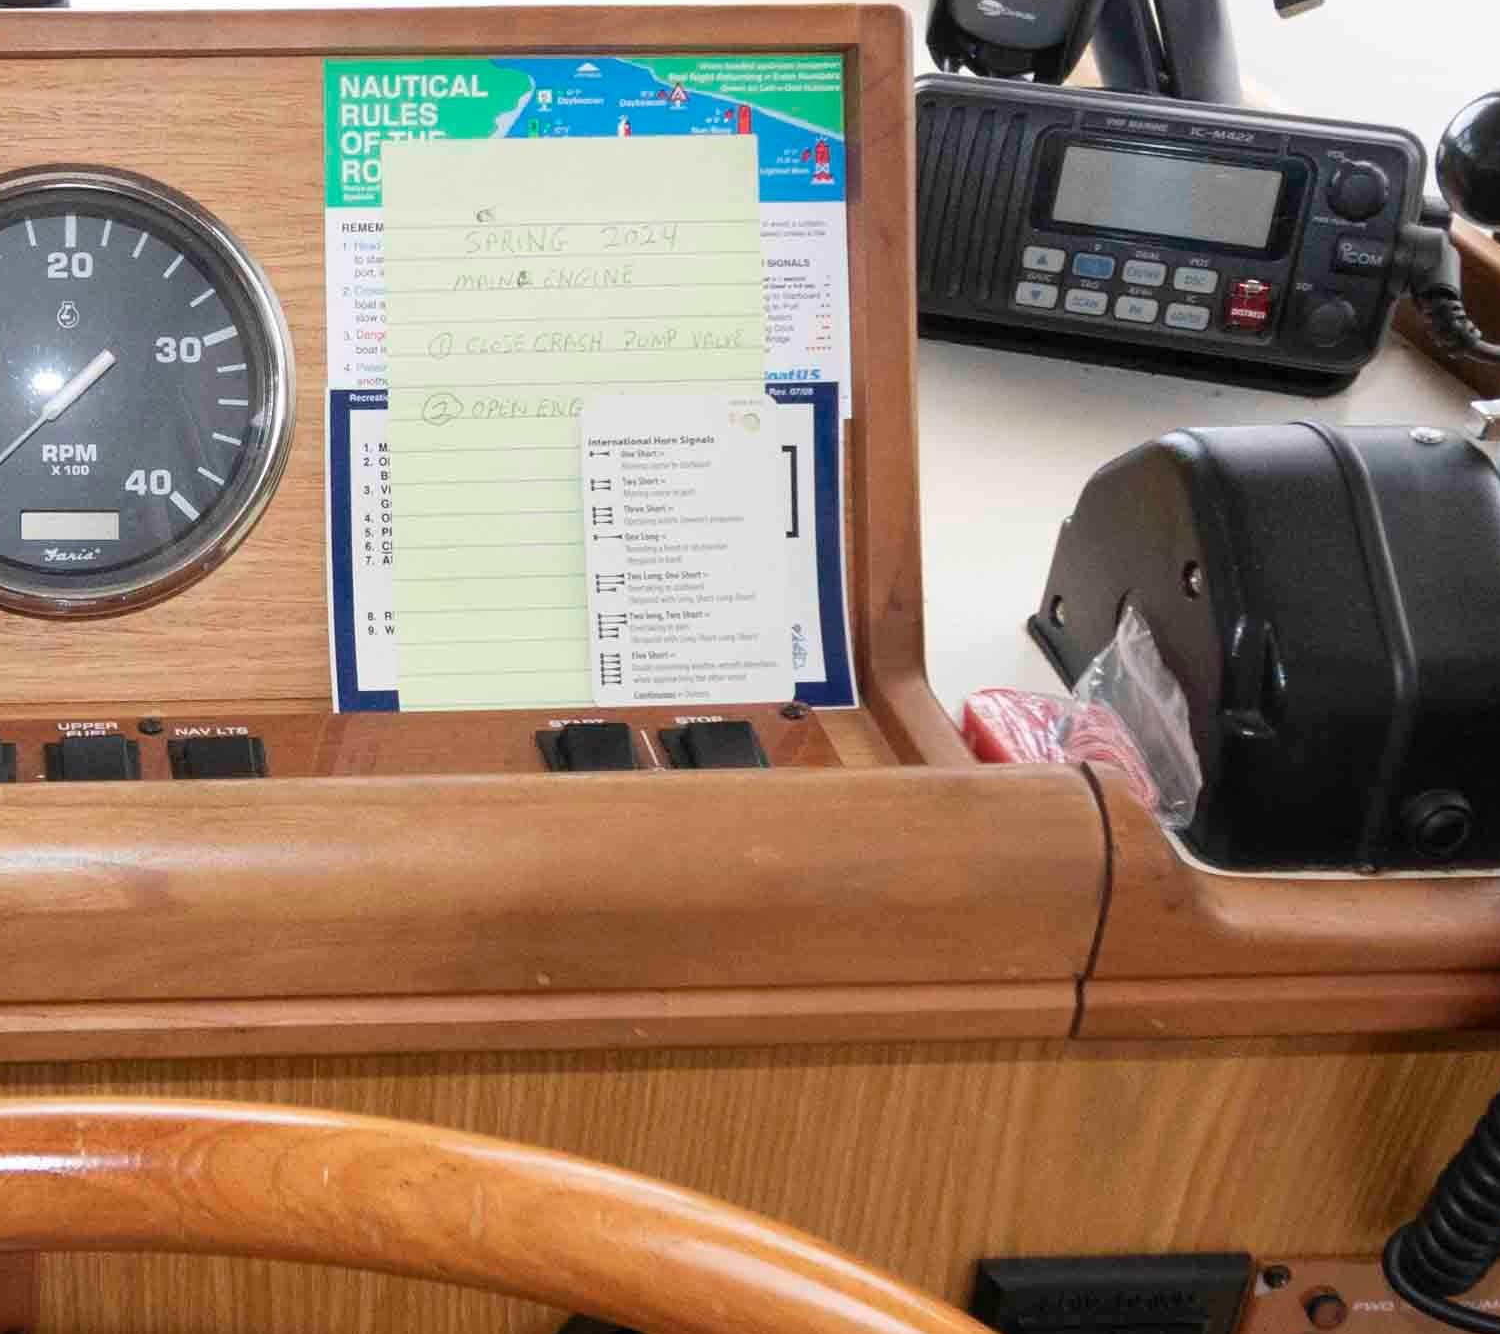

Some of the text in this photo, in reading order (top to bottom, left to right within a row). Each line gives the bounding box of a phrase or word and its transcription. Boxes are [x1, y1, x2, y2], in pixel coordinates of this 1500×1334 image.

[338, 74, 489, 99] NAUTICAL
[340, 103, 440, 127] RULES
[341, 130, 381, 155] OF
[465, 222, 681, 255] SPRING 2024
[47, 251, 94, 279] 20
[767, 258, 810, 268] SIGNALS
[542, 264, 634, 290] ENGINE
[155, 336, 202, 364] 30
[465, 335, 525, 356] CLOSE
[533, 330, 604, 354] CRASH
[623, 328, 678, 352] PUMP
[471, 398, 529, 419] OPEN
[588, 435, 716, 447] International Horn Signals
[41, 444, 97, 463] RPM
[51, 465, 90, 476] X 100
[124, 468, 173, 496] 40
[57, 722, 119, 732] UPPER
[674, 715, 724, 725] STOP
[175, 726, 249, 737] NAV LTS
[1352, 1300, 1395, 1312] FWD
